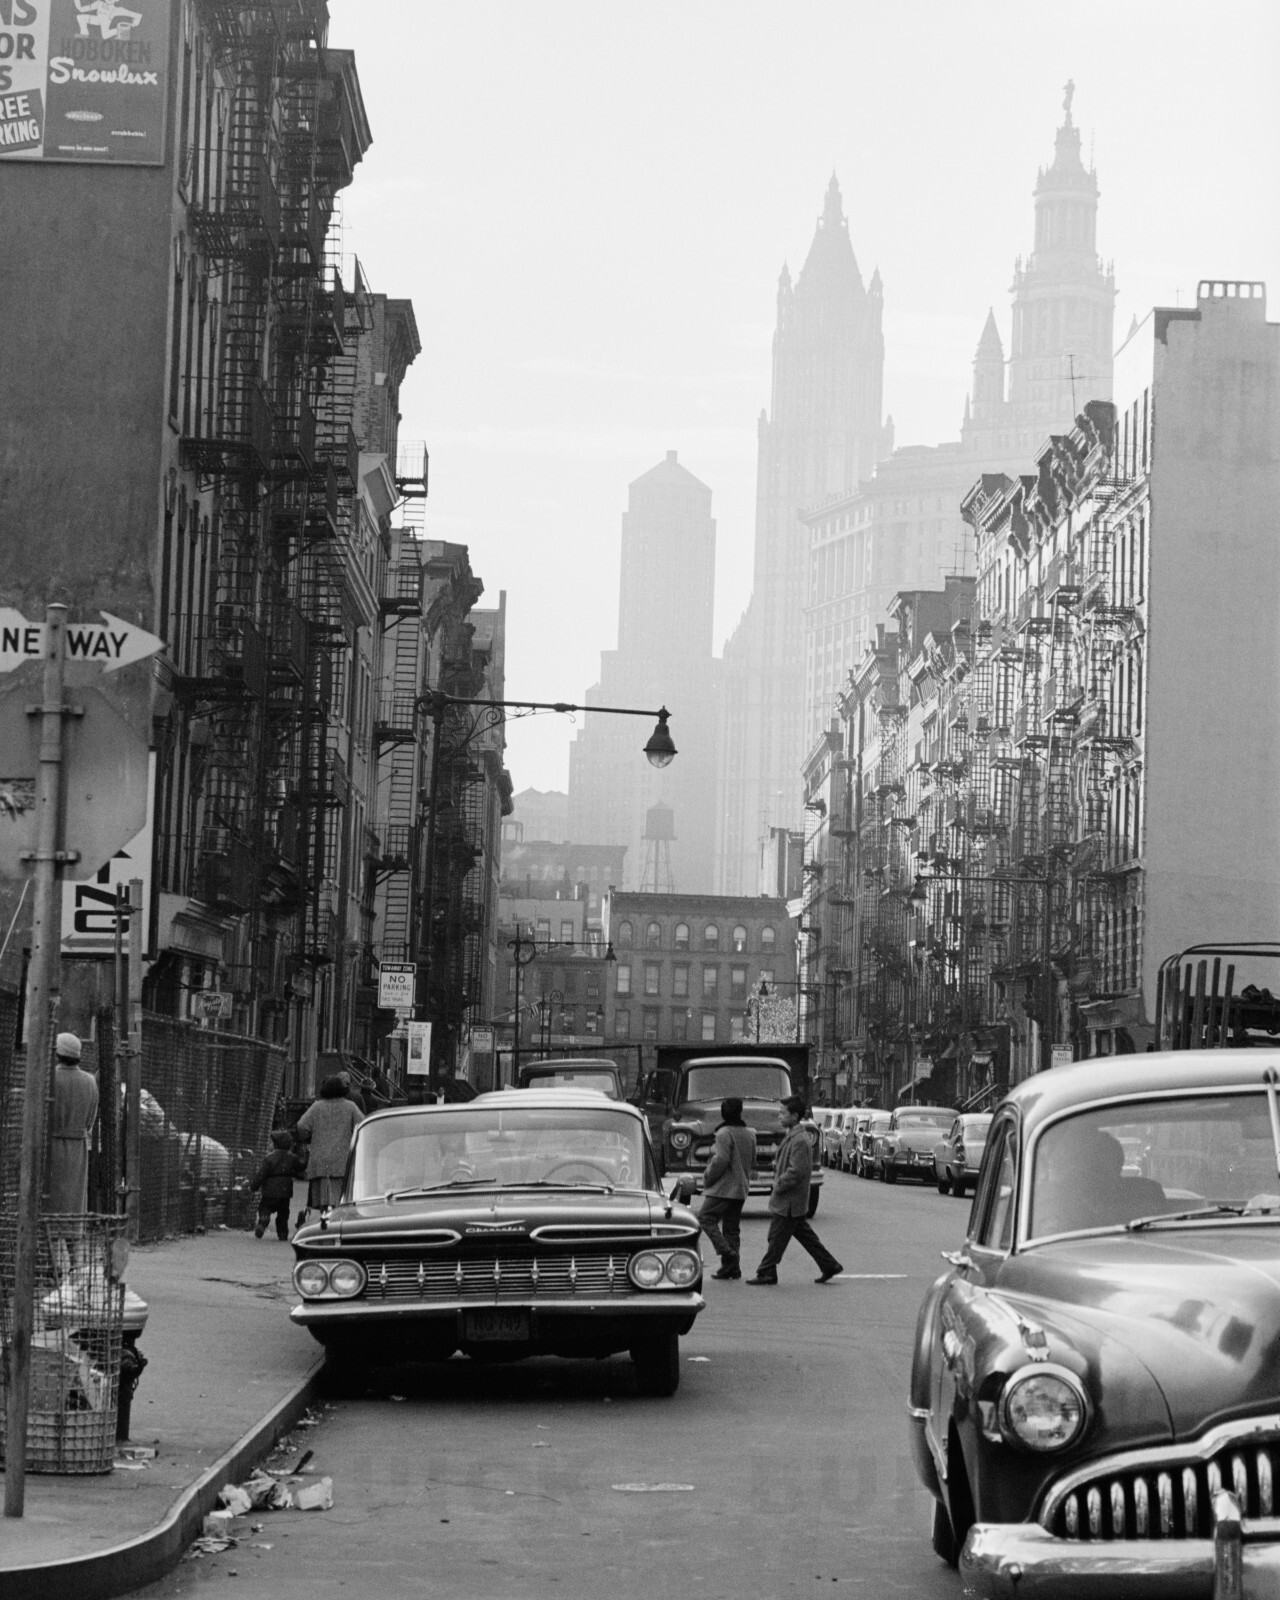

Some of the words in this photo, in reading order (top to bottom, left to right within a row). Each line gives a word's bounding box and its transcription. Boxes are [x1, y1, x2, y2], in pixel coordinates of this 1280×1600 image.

[50, 57, 158, 85] Snowlux
[2, 627, 40, 653] NE
[67, 630, 128, 657] WAY
[383, 983, 411, 991] PARKING
[389, 975, 406, 984] NO
